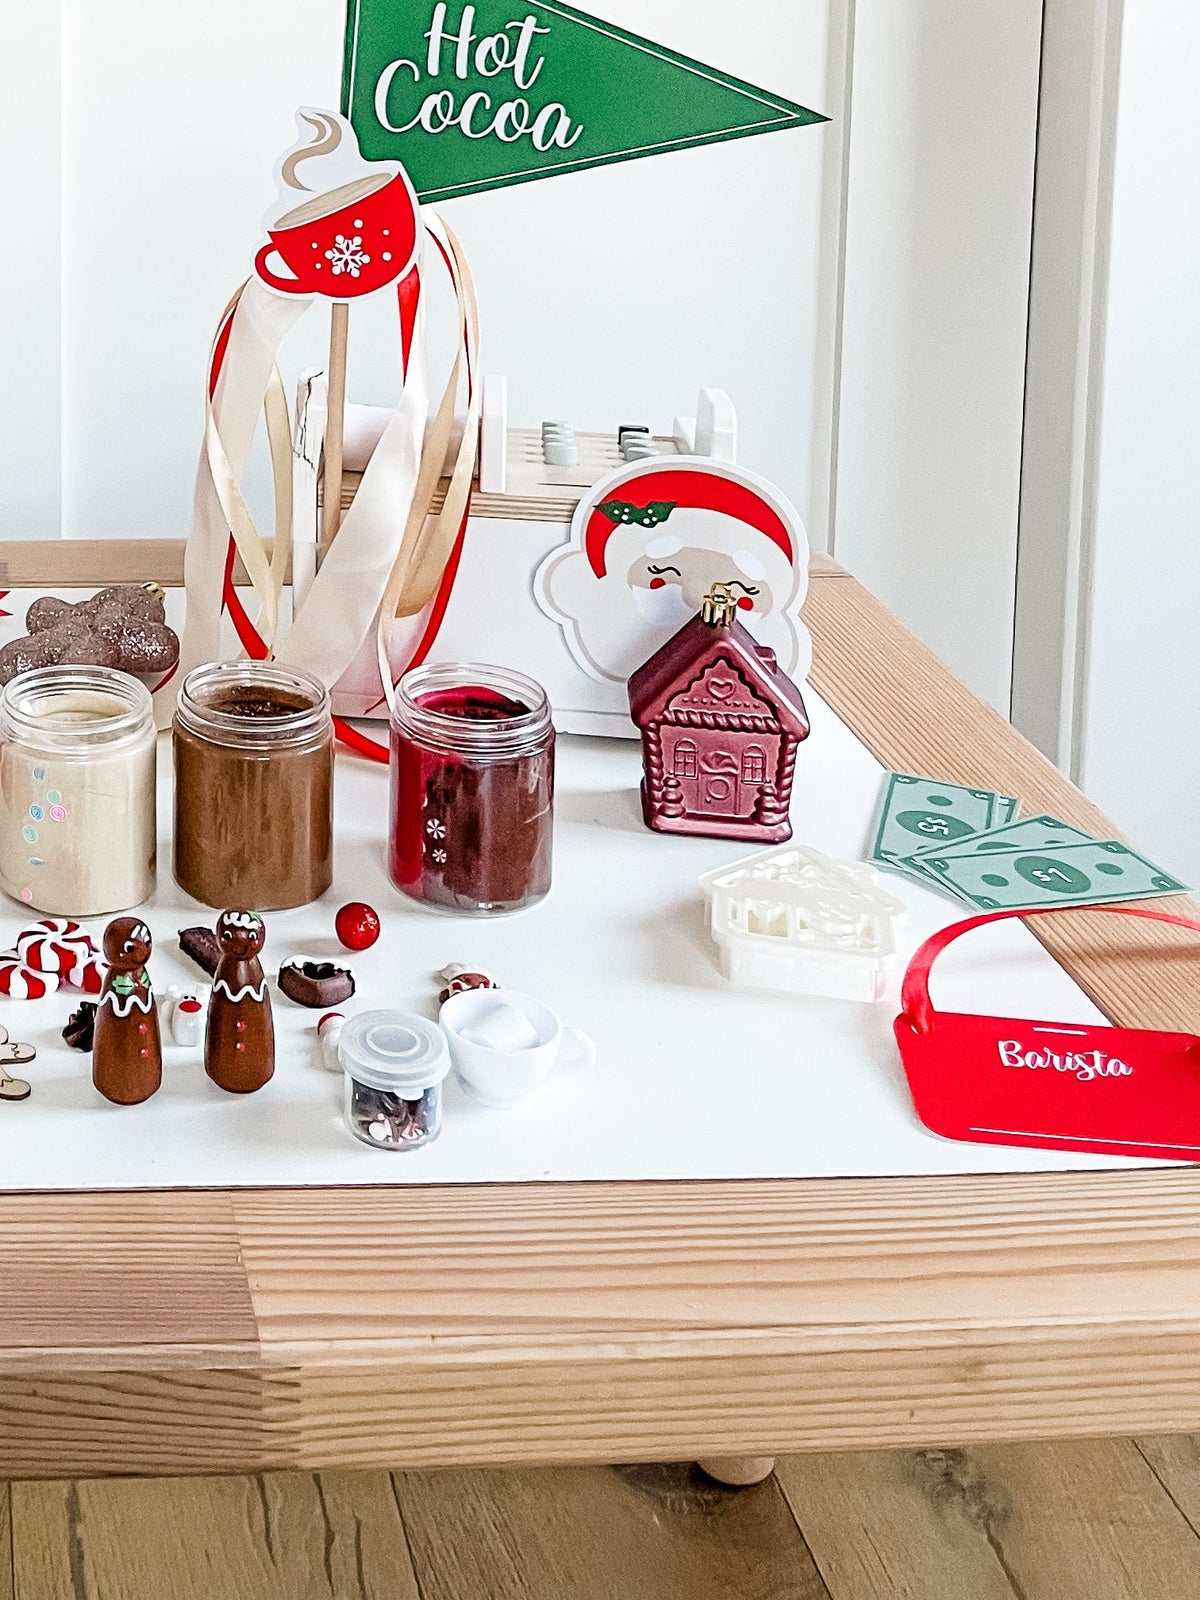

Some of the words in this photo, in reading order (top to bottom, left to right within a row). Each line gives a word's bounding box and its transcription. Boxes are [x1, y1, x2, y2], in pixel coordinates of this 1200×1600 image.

[423, 1, 551, 89] Hot
[374, 58, 584, 152] Cocoa
[997, 1040, 1135, 1082] Barista
